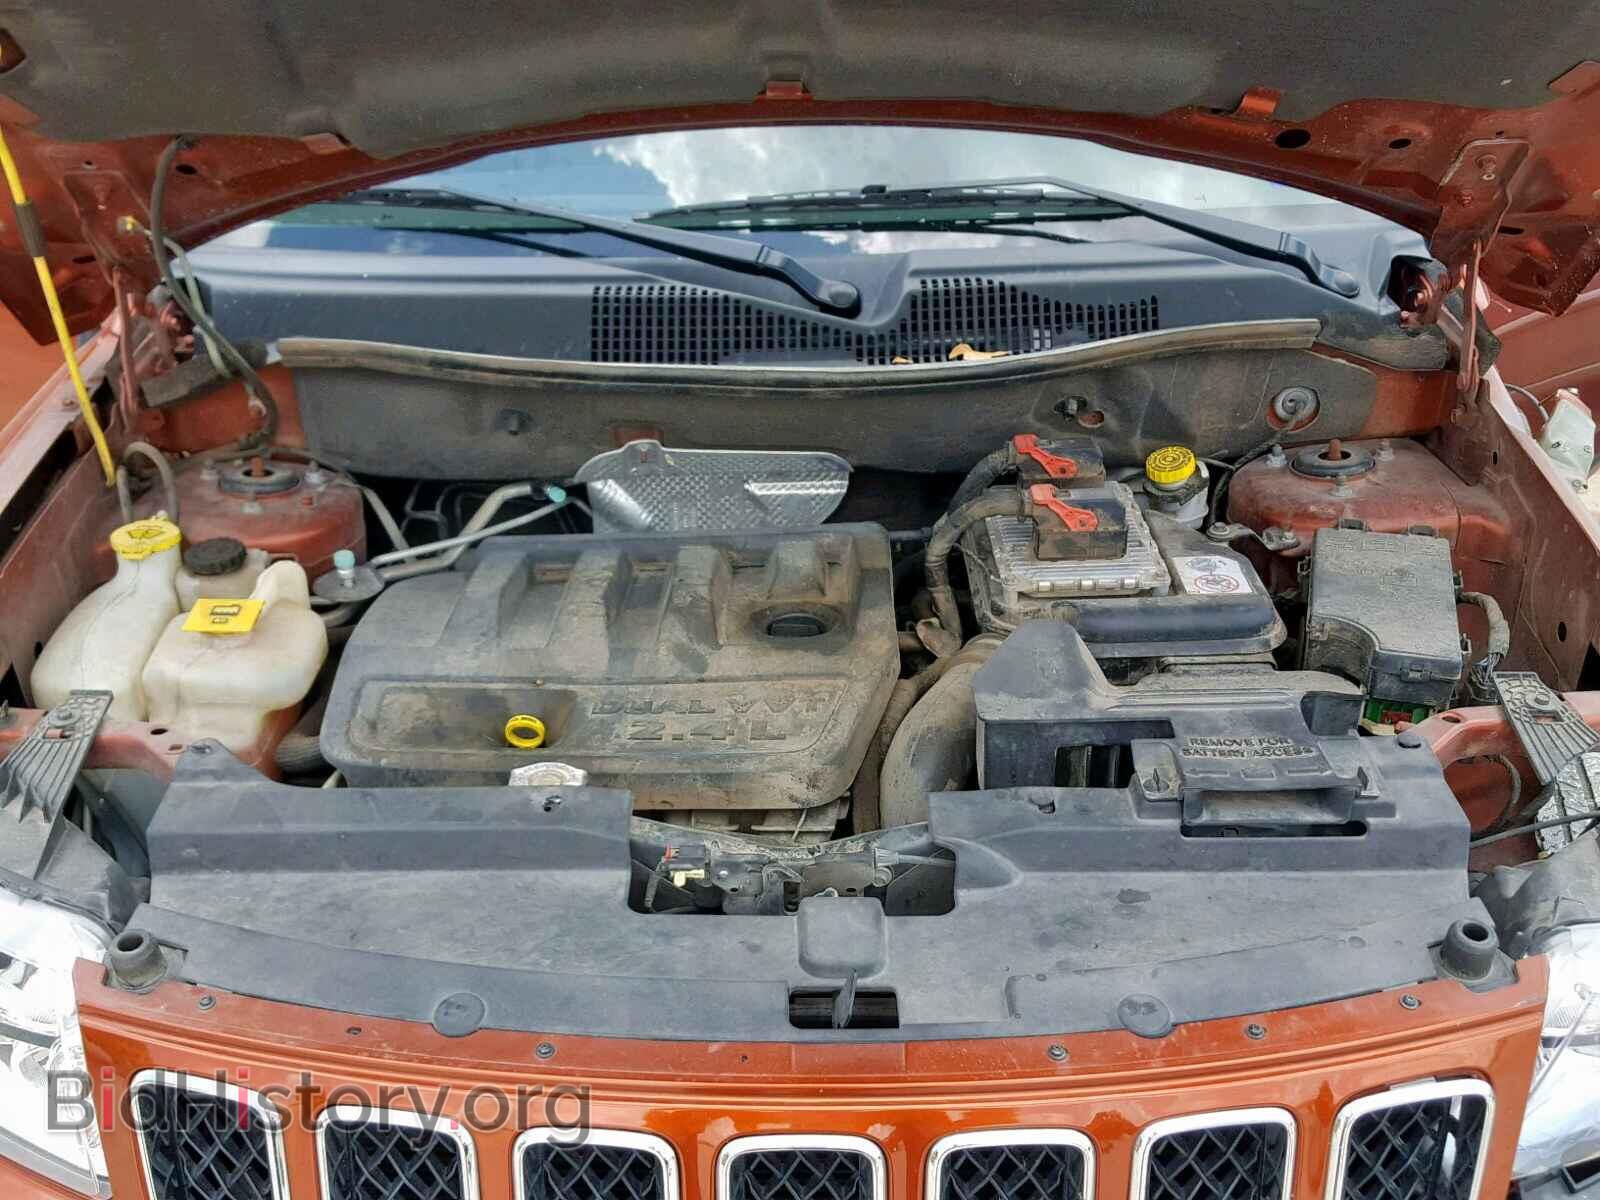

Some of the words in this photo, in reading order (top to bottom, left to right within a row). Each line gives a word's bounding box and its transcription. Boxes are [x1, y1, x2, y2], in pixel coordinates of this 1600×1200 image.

[627, 719, 787, 741] 2.4L
[1189, 737, 1255, 747] REMOVE
[1258, 736, 1291, 747] FOR
[1182, 747, 1246, 758] BATTERY
[1251, 746, 1314, 758] ACCESS
